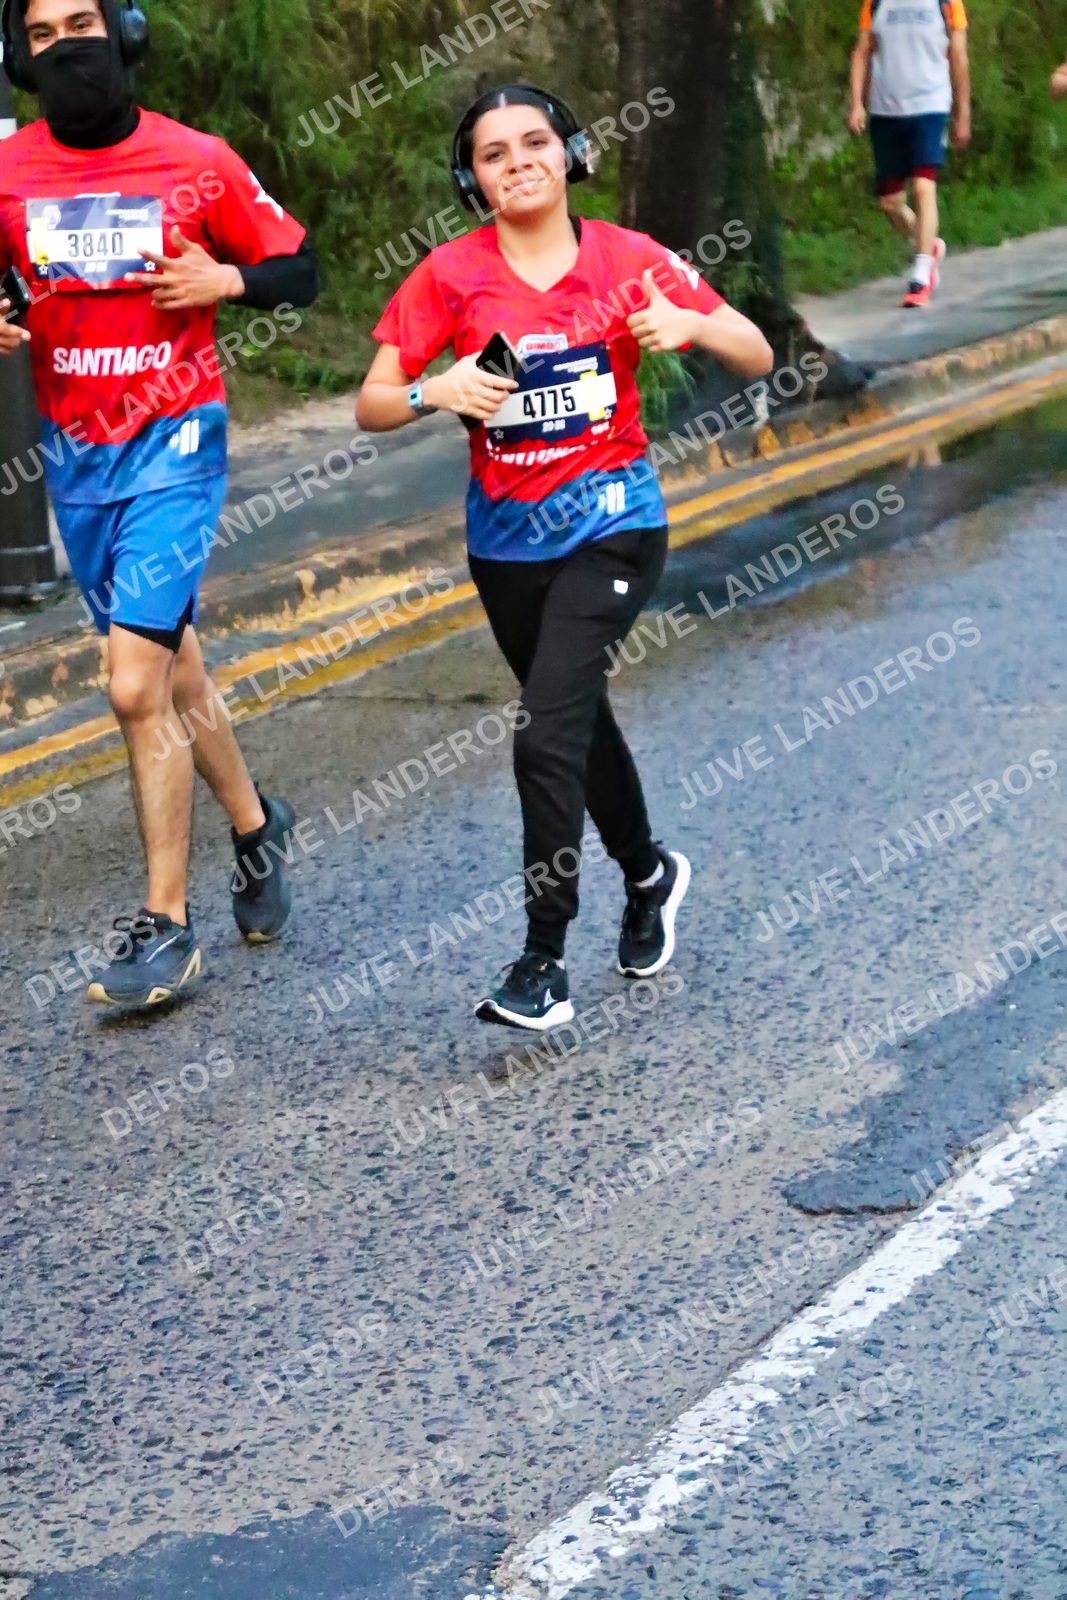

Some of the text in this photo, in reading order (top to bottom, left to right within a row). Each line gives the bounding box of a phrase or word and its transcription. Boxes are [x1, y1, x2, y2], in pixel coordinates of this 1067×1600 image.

[67, 232, 124, 258] 3840
[53, 341, 172, 377] SANTIAGO
[523, 386, 577, 419] 4775
